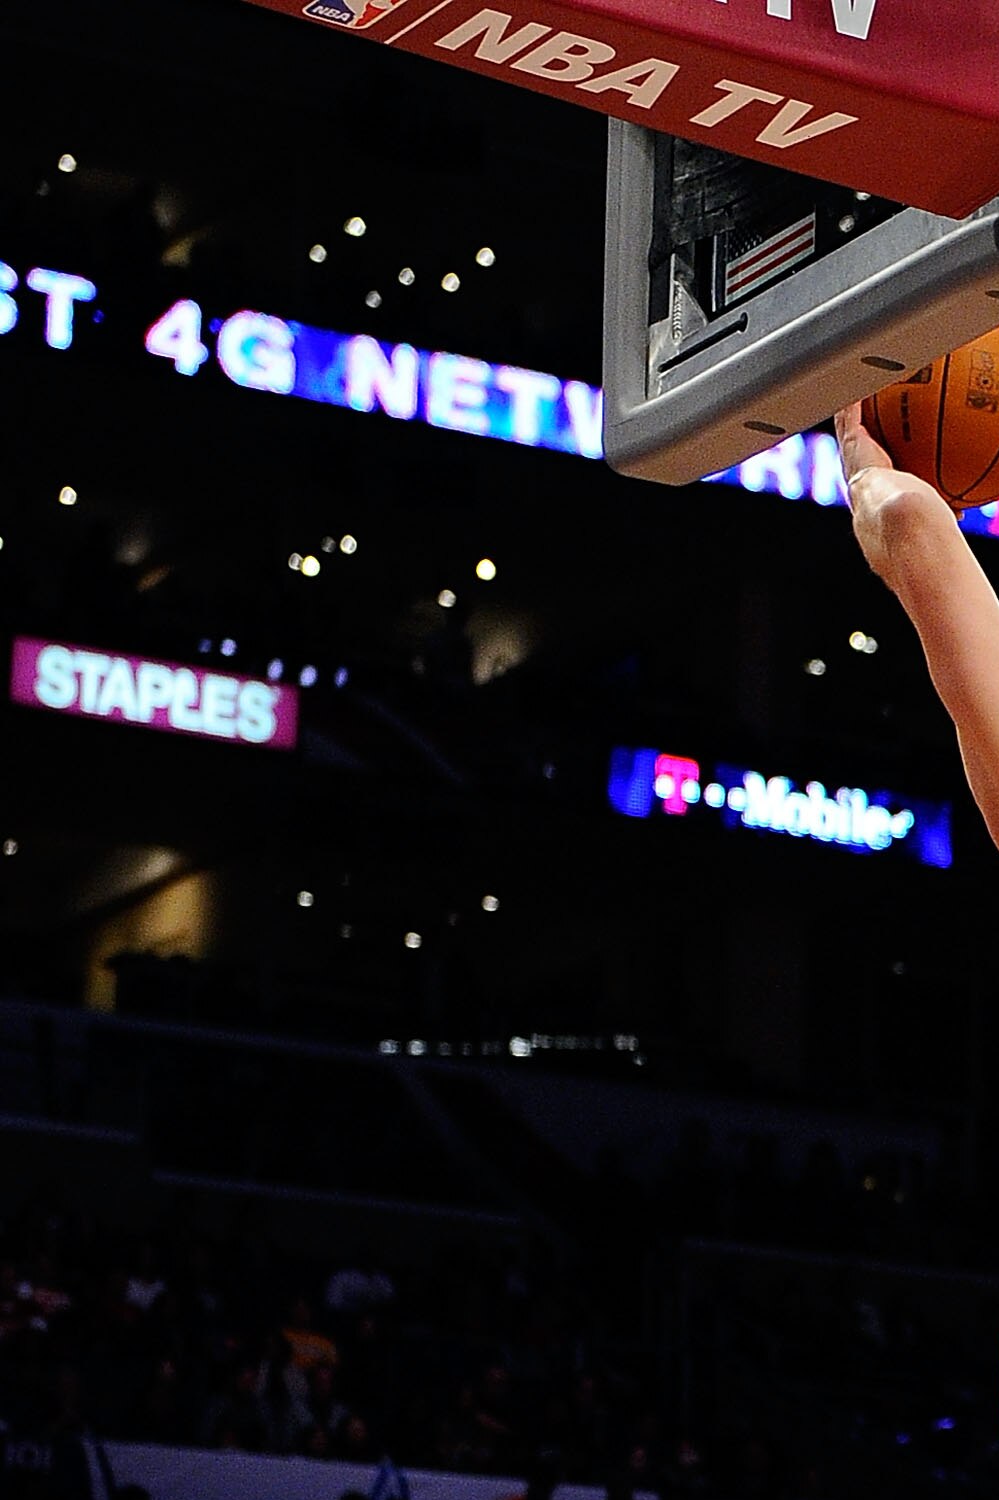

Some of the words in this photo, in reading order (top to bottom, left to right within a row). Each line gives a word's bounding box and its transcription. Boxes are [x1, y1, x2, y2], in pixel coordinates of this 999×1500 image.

[312, 5, 352, 21] NBA
[433, 8, 681, 110] NBA
[688, 79, 859, 149] TV
[145, 299, 297, 394] 4G
[34, 644, 278, 744] STAPLES
